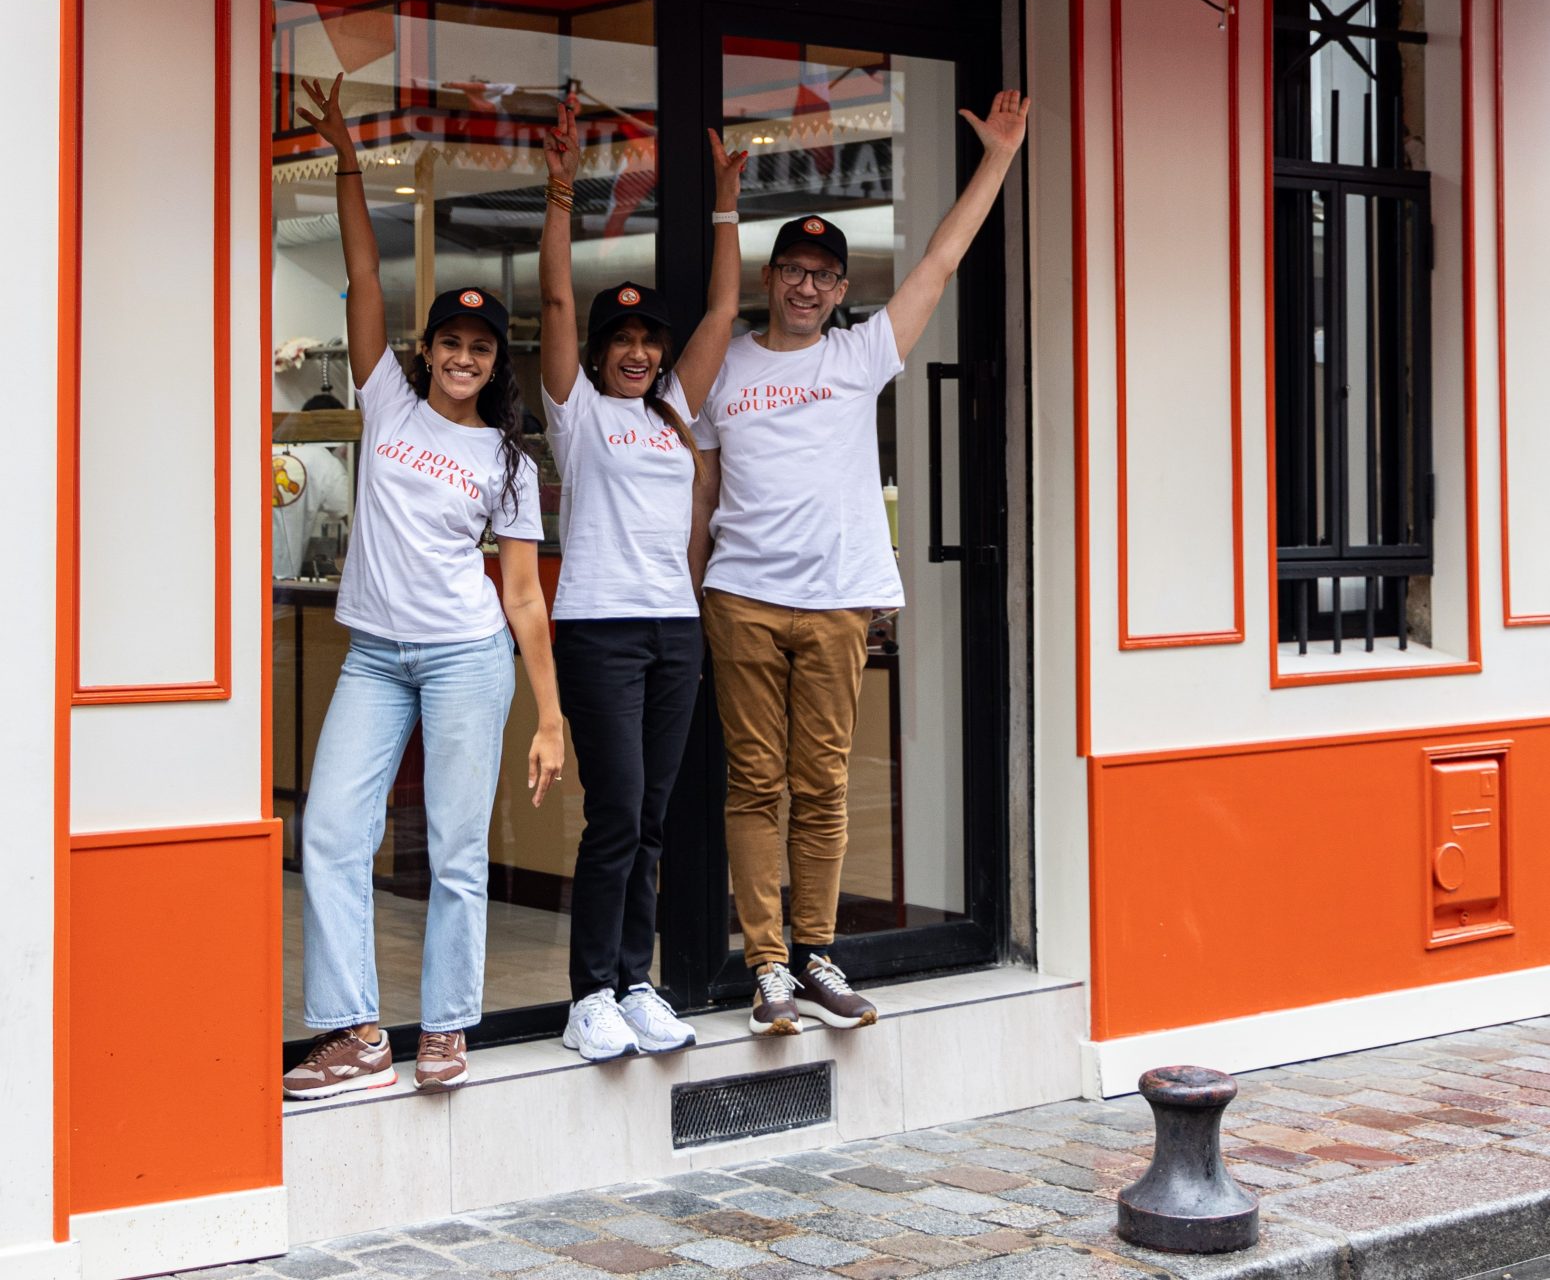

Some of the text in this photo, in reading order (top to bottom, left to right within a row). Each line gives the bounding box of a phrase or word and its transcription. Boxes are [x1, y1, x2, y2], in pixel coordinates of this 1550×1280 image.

[727, 387, 832, 416] GOURMAND
[741, 387, 757, 398] TI
[376, 443, 480, 500] GOURMAND
[396, 438, 474, 478] TI DODO
